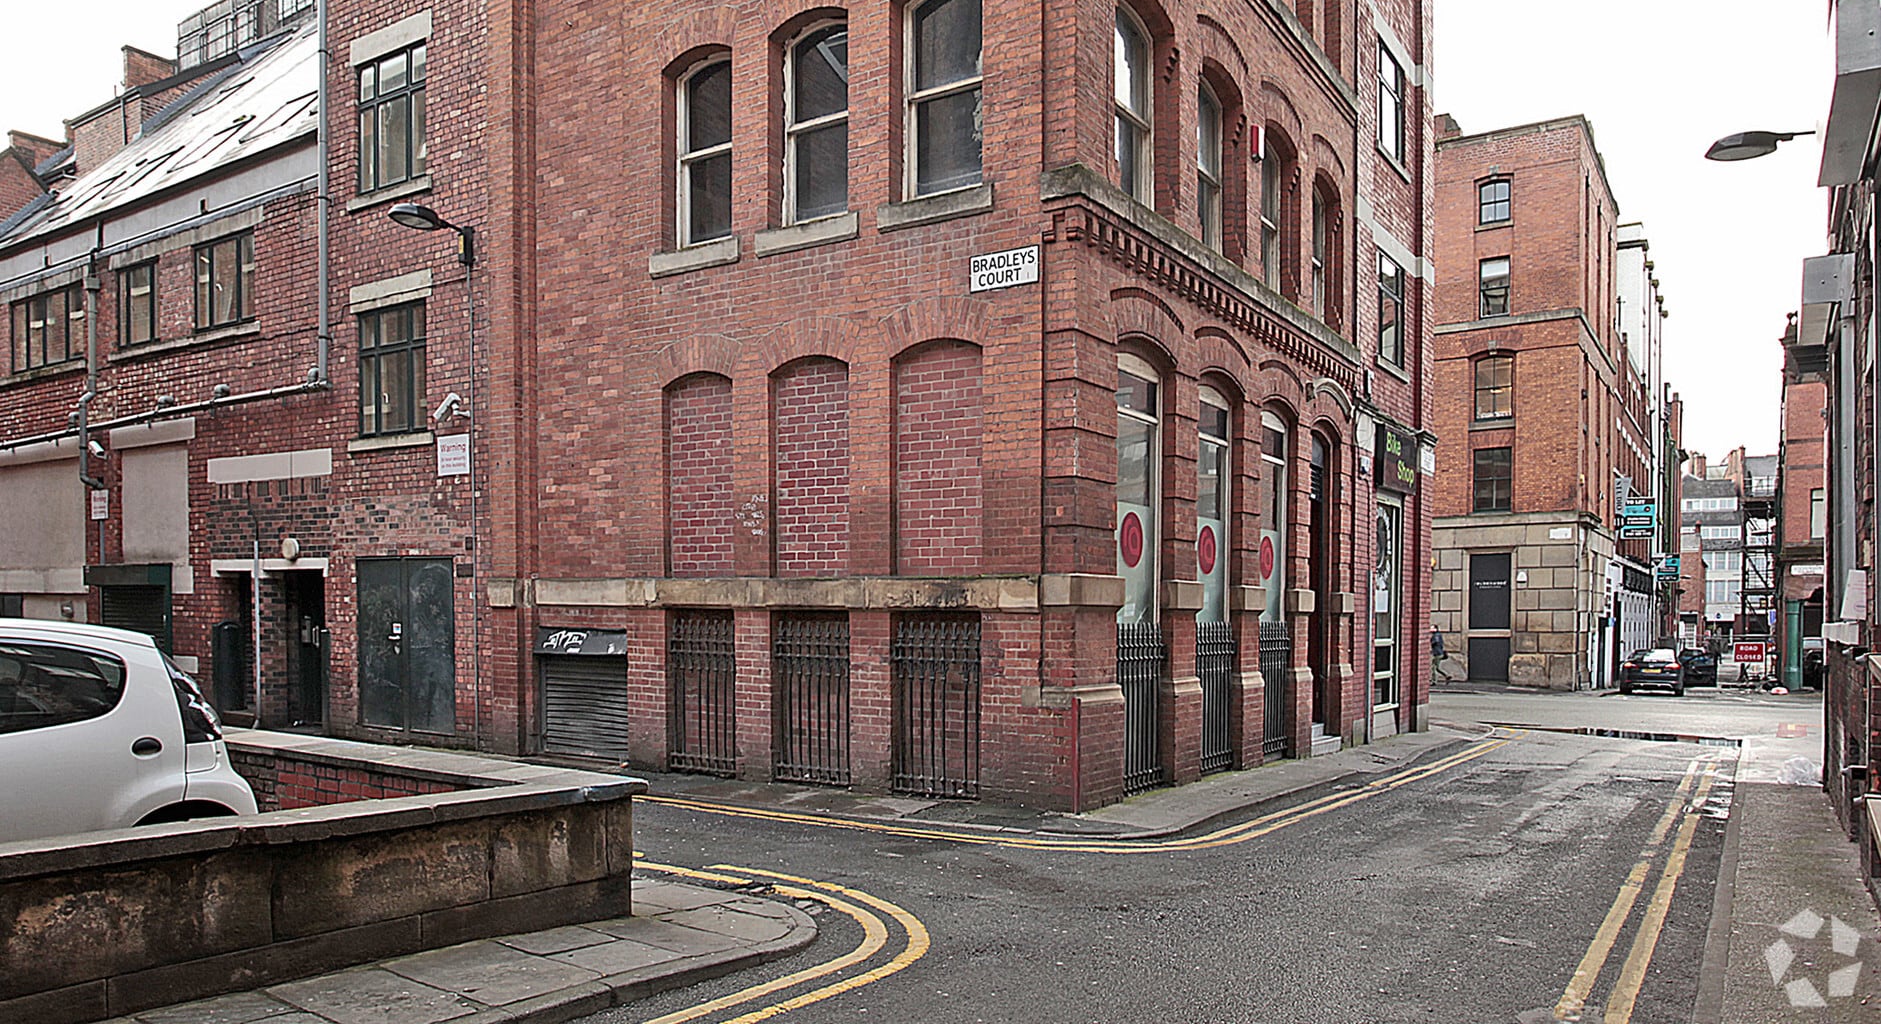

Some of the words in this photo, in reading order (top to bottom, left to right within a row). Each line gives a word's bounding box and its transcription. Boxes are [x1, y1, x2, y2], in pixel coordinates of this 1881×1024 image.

[973, 250, 1035, 273] BRADLEYS
[979, 268, 1022, 286] COURT
[1386, 432, 1402, 456] Bike
[1397, 460, 1415, 487] Shop
